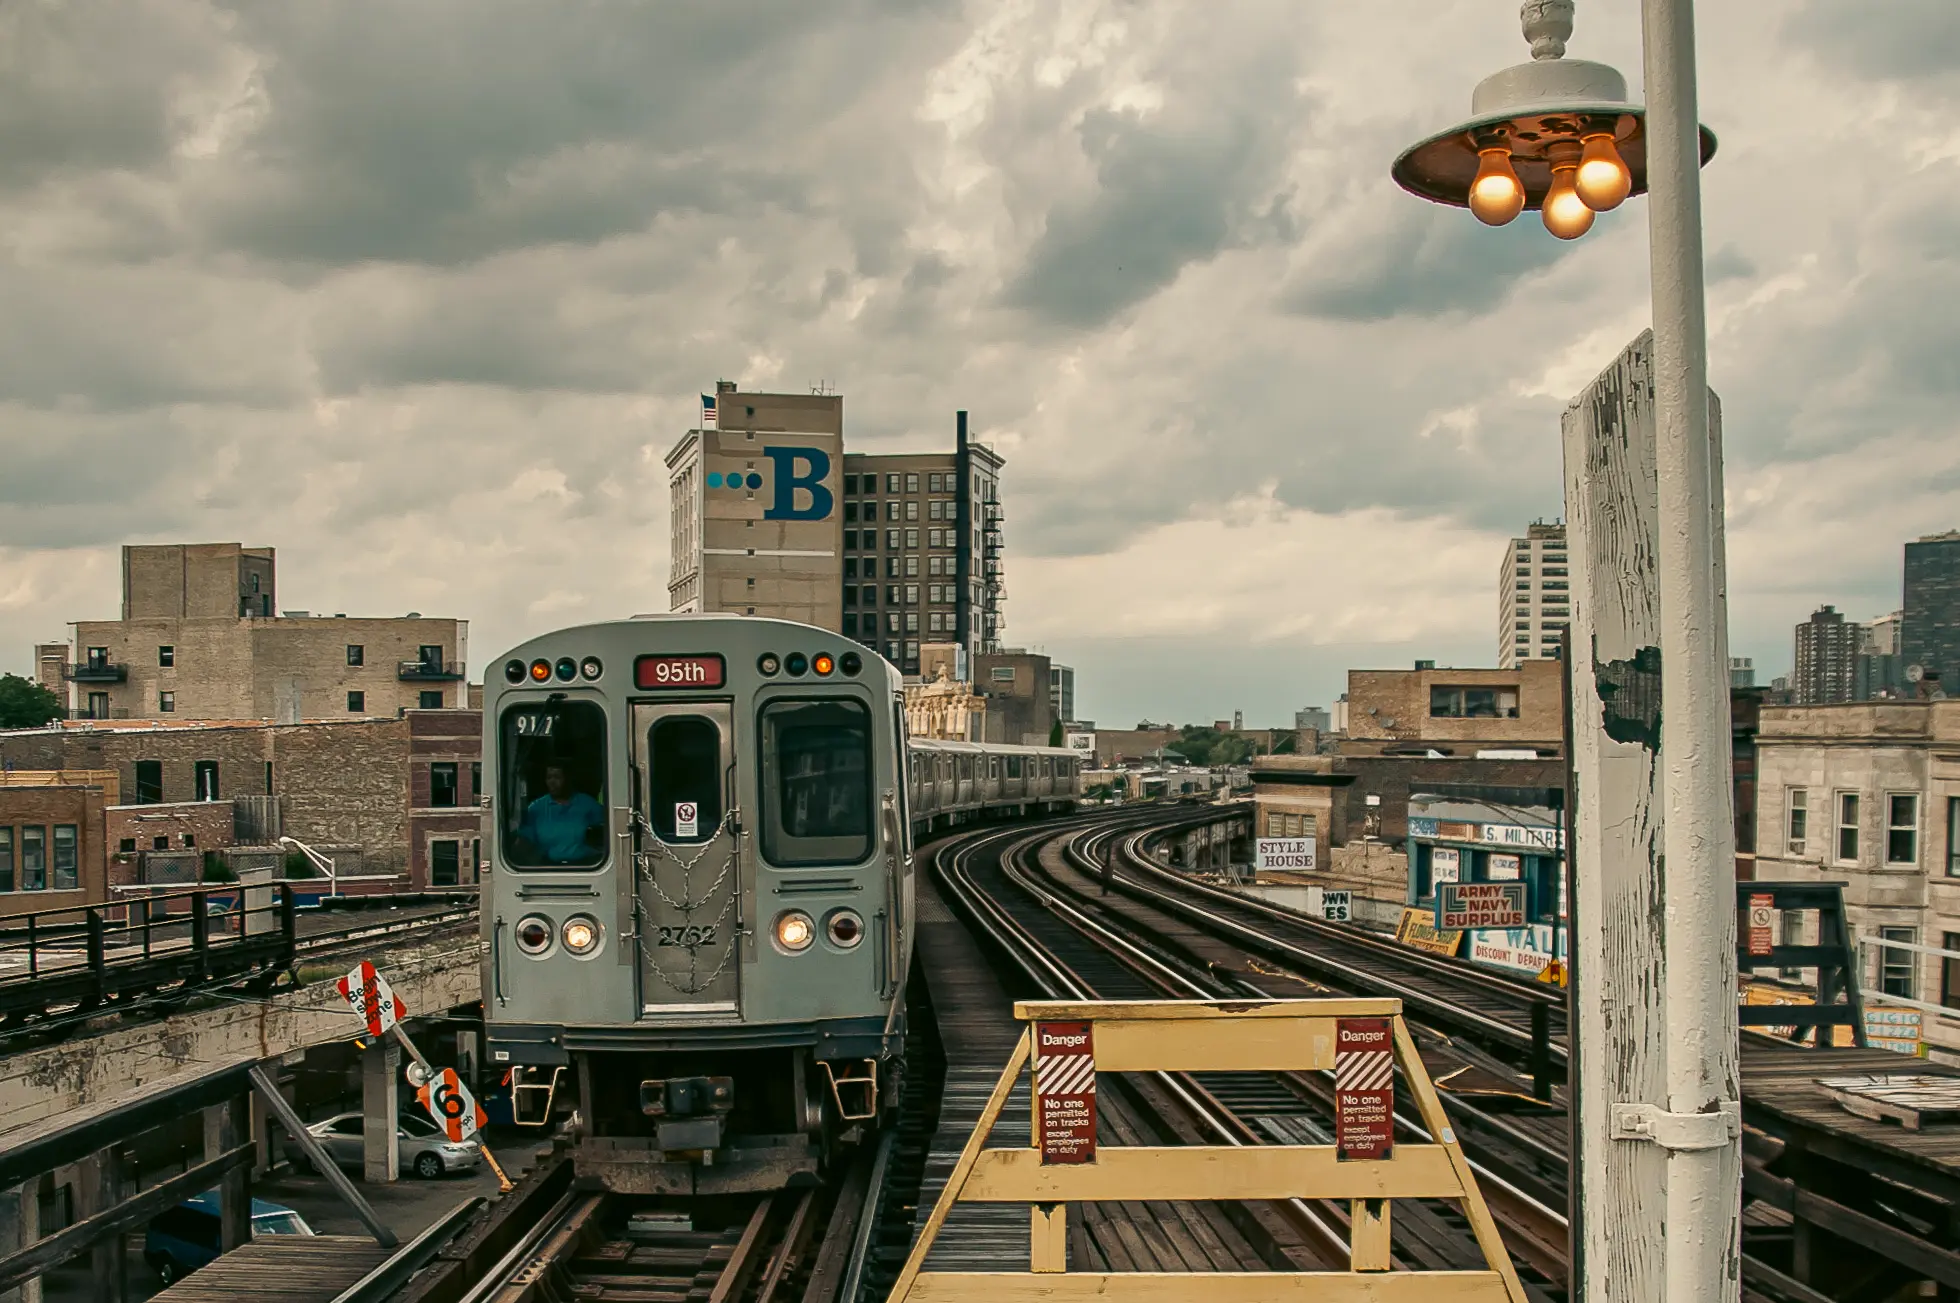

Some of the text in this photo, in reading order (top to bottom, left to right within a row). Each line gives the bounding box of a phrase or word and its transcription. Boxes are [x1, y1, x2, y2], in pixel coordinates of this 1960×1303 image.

[764, 446, 833, 520] B
[656, 662, 705, 682] 95th
[1505, 828, 1563, 846] MILITAR
[1260, 842, 1305, 853] STYLE
[1265, 856, 1313, 867] HOUSE
[1458, 886, 1502, 898] ARMY
[1468, 900, 1510, 911] NAVY
[1322, 906, 1348, 920] ES
[1445, 912, 1523, 927] SURPLUS
[658, 926, 717, 947] 2762
[1476, 945, 1511, 962] DISCOUNT
[348, 976, 381, 1003] Begin
[356, 990, 383, 1014] slow
[364, 1000, 393, 1024] zone
[1042, 1034, 1088, 1048] Danger
[1341, 1030, 1386, 1043] Danger
[433, 1083, 466, 1118] 6
[1044, 1099, 1085, 1109] No one
[1342, 1095, 1382, 1105] No one
[1045, 1108, 1089, 1119] permitted
[1343, 1105, 1387, 1115] permitted
[1045, 1117, 1089, 1127] on tracks
[1358, 1114, 1386, 1123] tracks
[1046, 1129, 1074, 1138] except
[1343, 1126, 1371, 1134] except
[1046, 1138, 1089, 1147] employees
[1343, 1134, 1386, 1144] employees
[1046, 1144, 1078, 1155] on duty
[1356, 1140, 1376, 1151] duty
